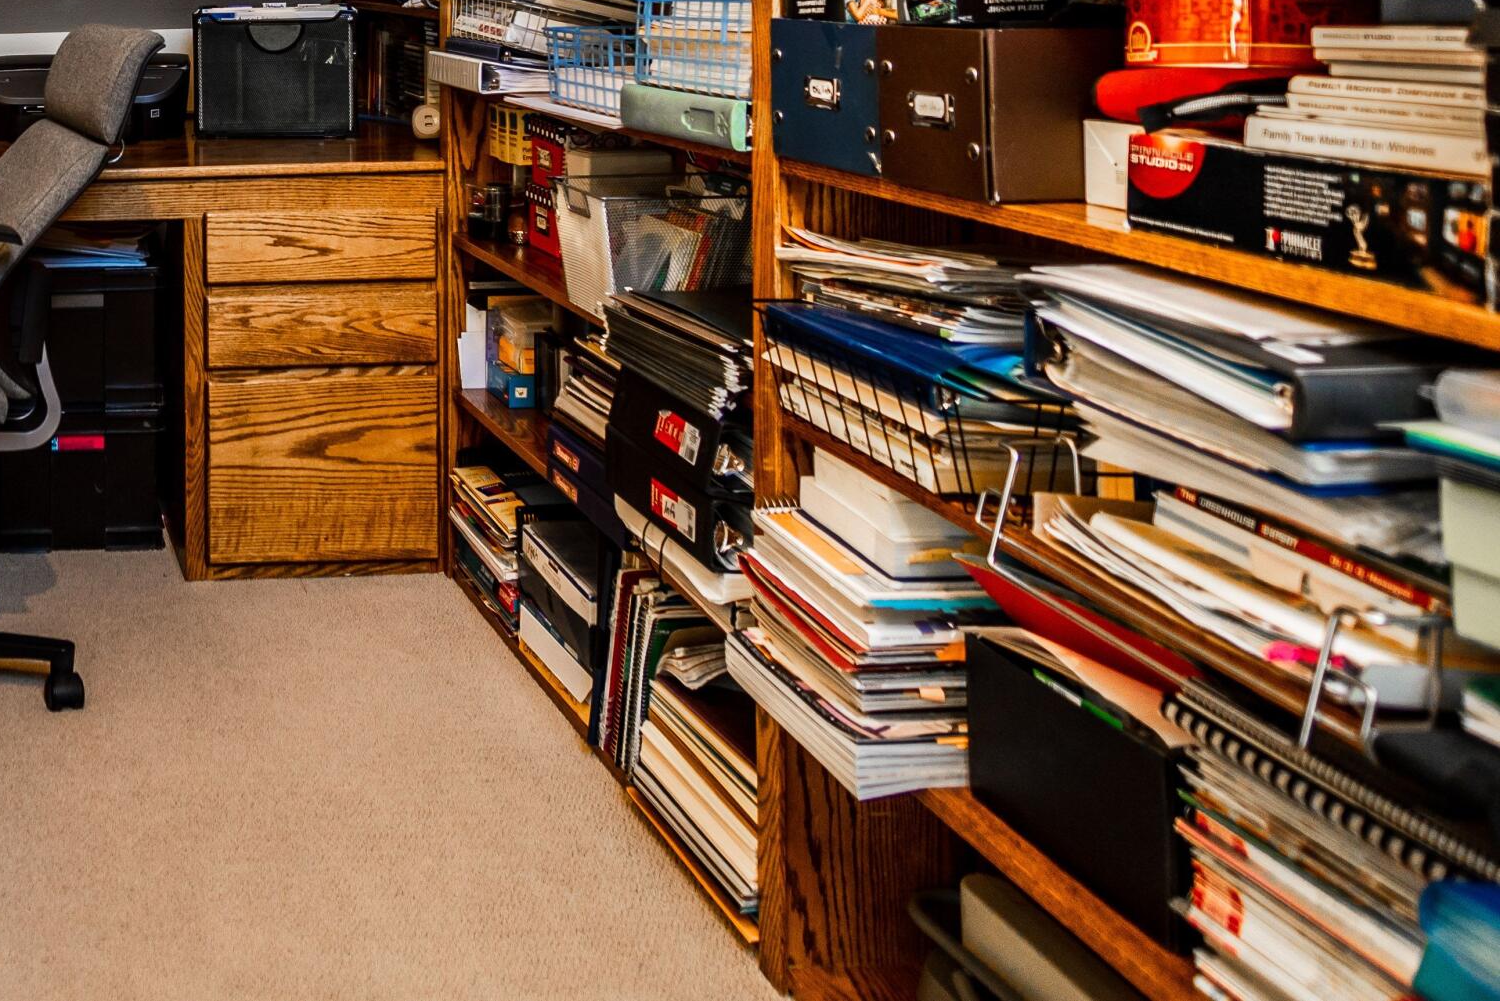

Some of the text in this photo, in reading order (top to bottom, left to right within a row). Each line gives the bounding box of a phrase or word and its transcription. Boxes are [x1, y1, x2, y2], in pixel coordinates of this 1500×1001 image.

[1261, 127, 1292, 143] Family
[1295, 132, 1315, 143] Tree
[1130, 153, 1178, 171] STUDIO
[1131, 144, 1195, 163] PINNACLE
